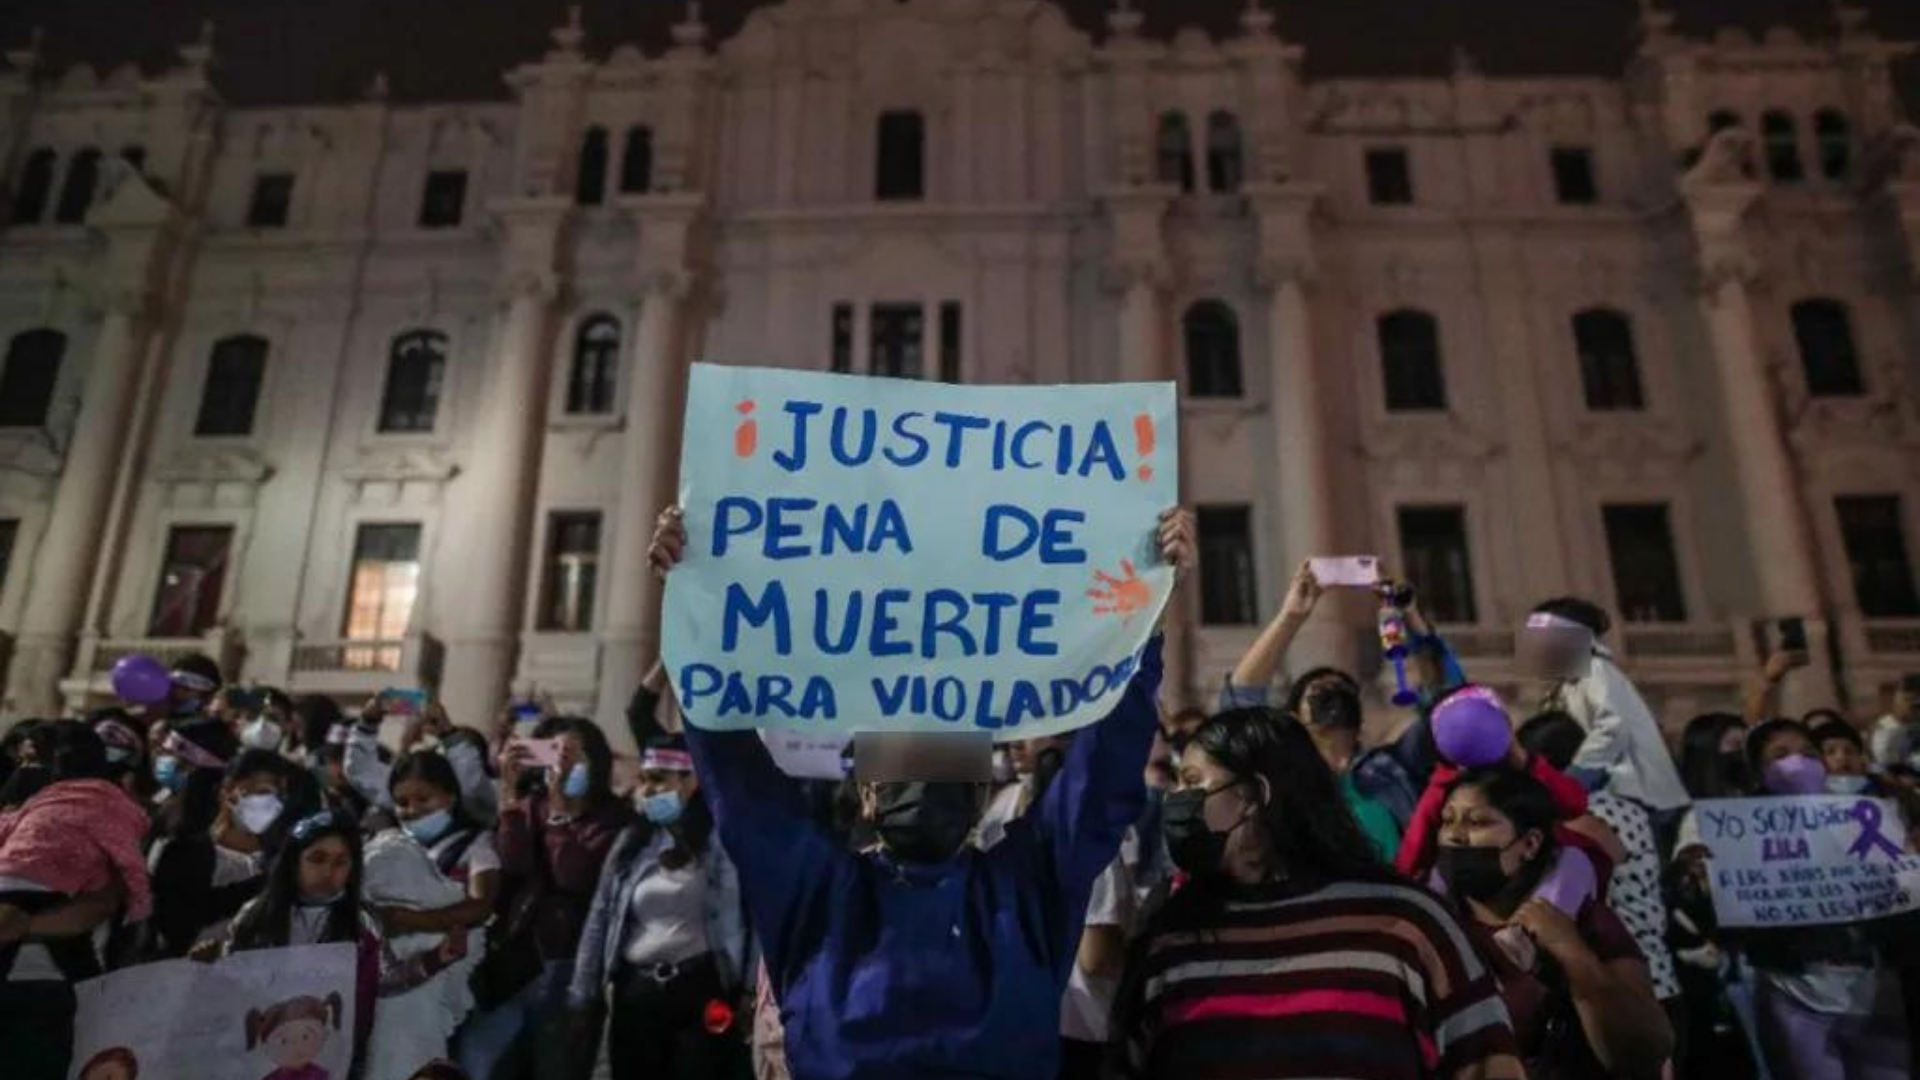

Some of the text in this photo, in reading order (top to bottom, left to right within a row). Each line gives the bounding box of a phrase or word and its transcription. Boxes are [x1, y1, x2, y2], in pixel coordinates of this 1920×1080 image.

[734, 399, 1156, 482] ¡JUSTICIA!
[711, 496, 1088, 564] PENA DE
[721, 580, 1061, 659] MUERTE
[680, 662, 837, 719] PARA
[1704, 809, 1746, 841] YO
[1752, 805, 1798, 835] SOY
[1754, 905, 1781, 922] NO
[1786, 904, 1809, 921] SE
